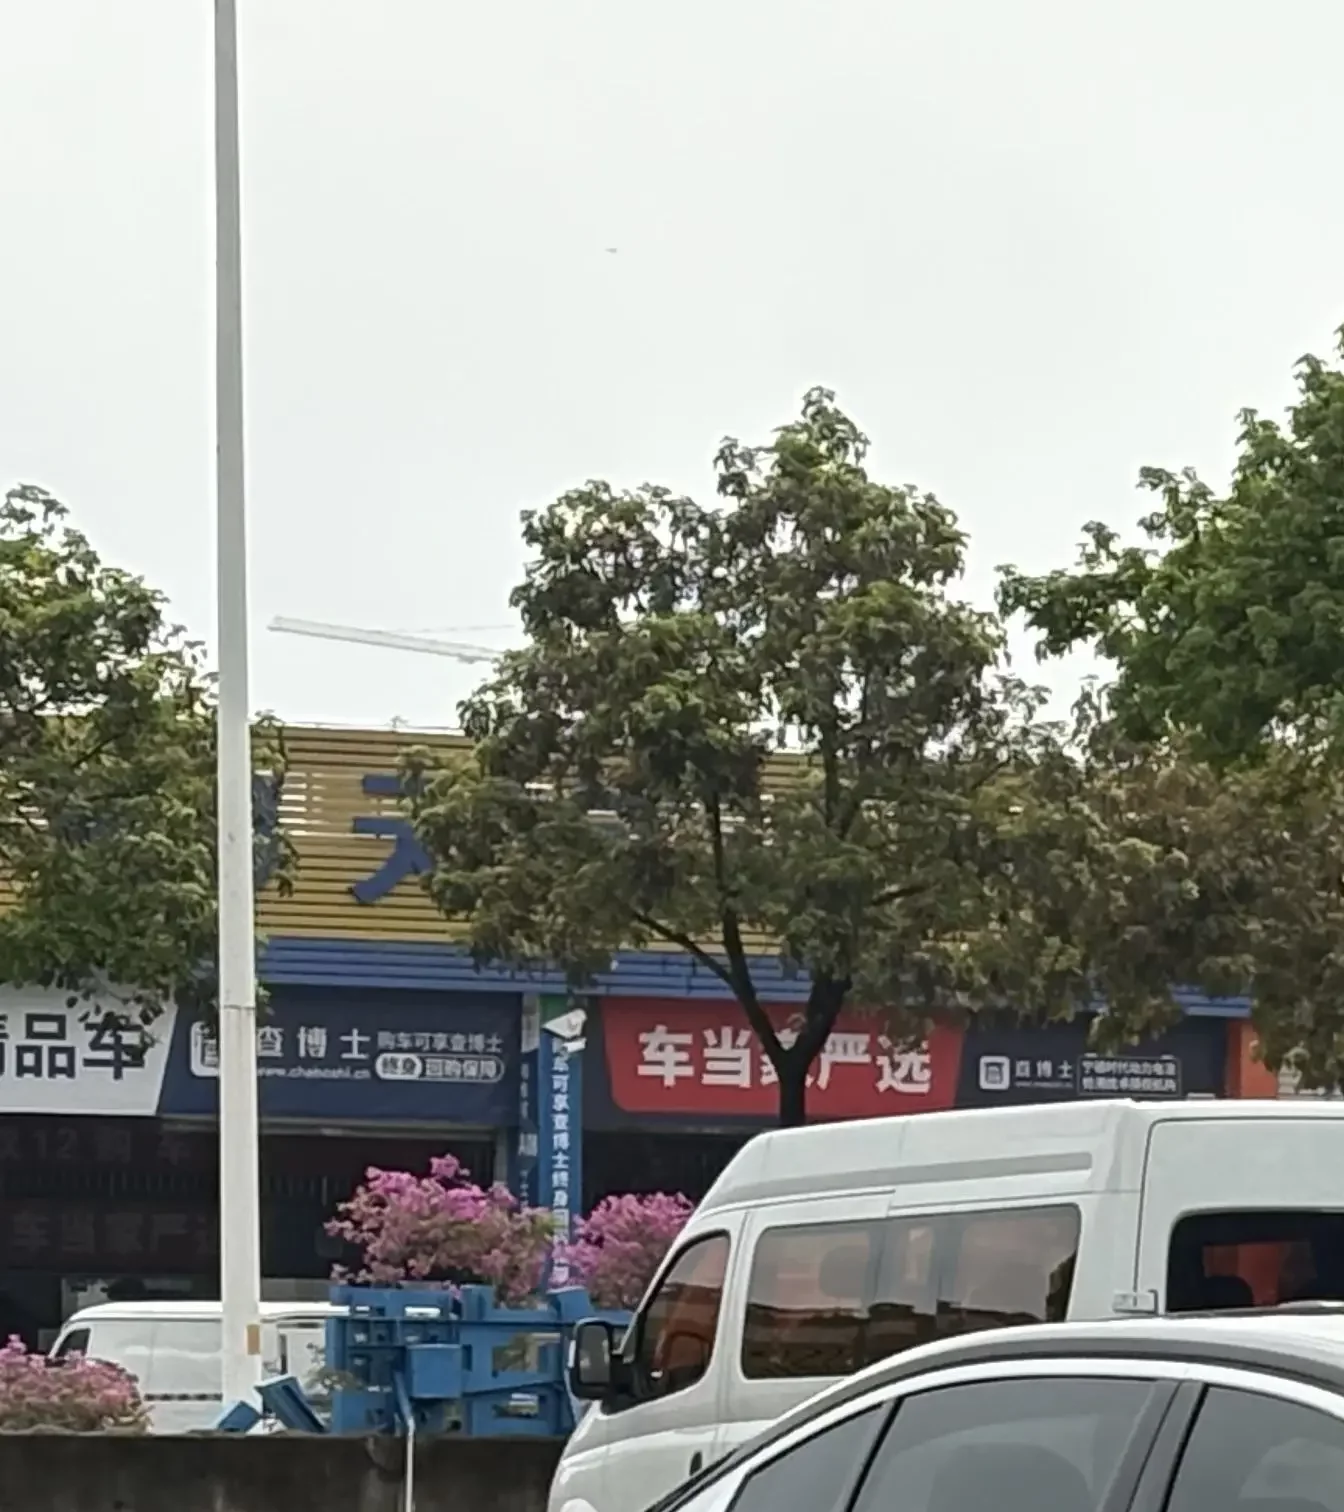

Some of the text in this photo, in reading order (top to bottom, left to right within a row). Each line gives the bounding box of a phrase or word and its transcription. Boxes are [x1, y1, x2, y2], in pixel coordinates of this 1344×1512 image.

[0, 1012, 145, 1080] 品车
[258, 1026, 370, 1059] 查博士
